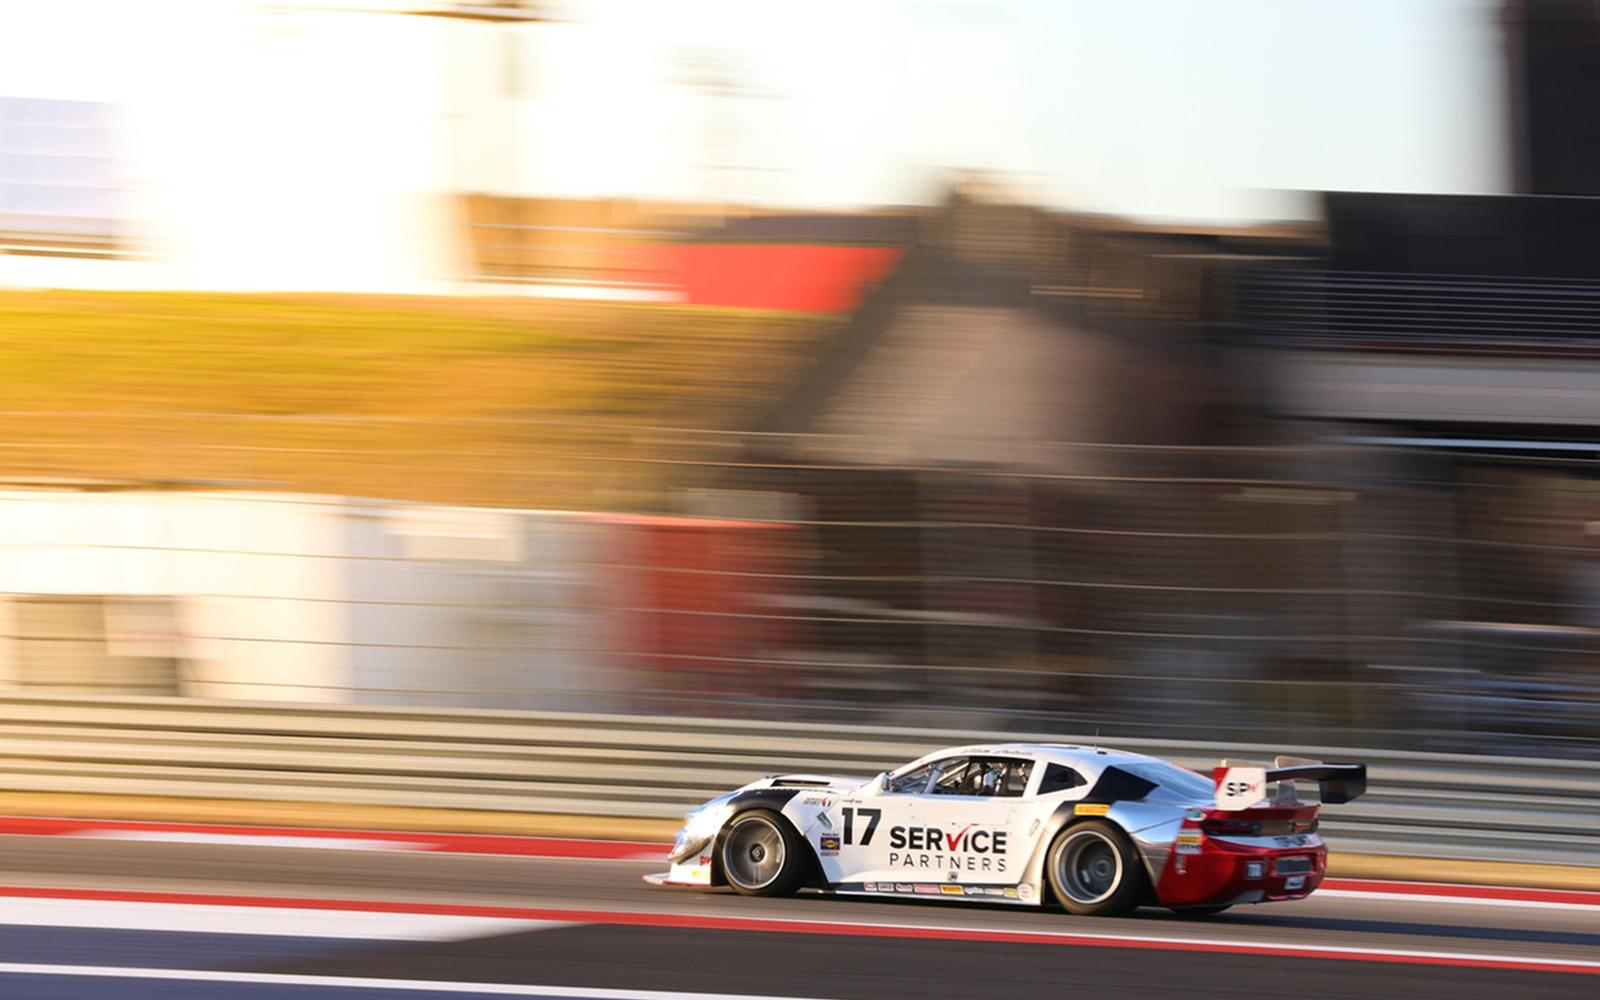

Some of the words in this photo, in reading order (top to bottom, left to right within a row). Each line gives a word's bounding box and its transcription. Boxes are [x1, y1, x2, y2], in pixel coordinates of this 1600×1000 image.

[841, 807, 882, 846] 17
[889, 825, 1007, 854] SERVICE
[889, 852, 1007, 872] PARTNERS
